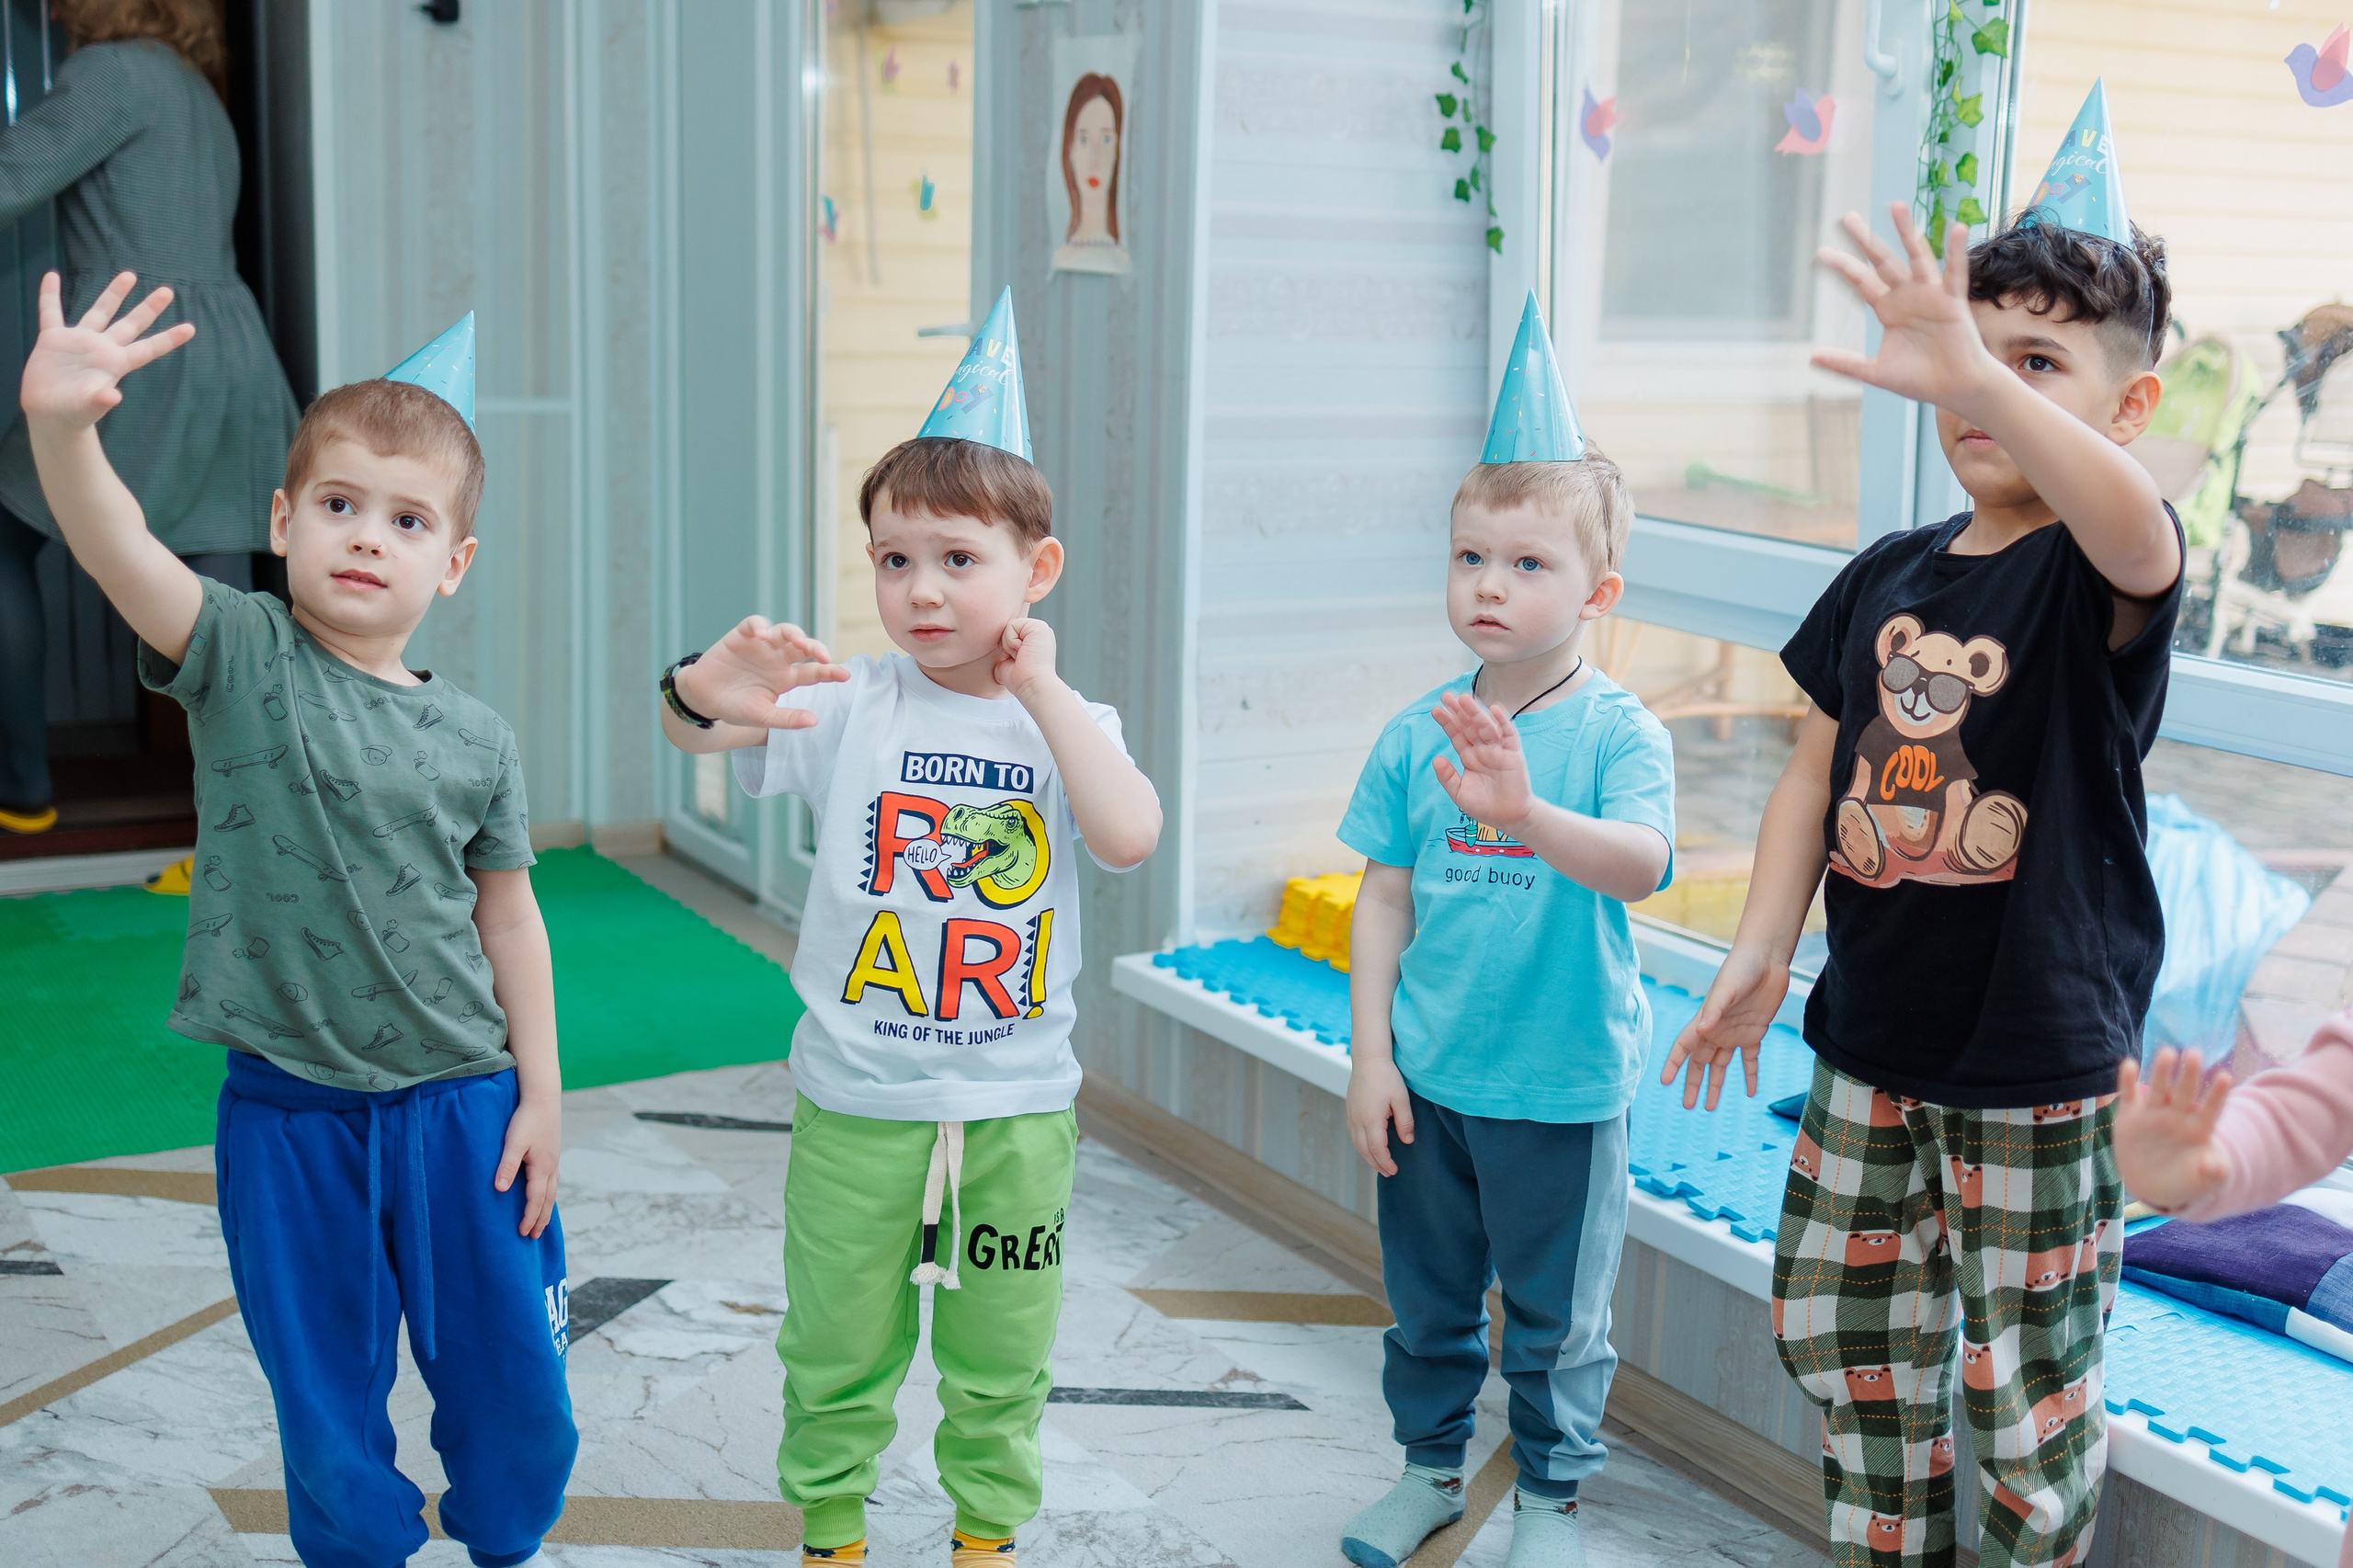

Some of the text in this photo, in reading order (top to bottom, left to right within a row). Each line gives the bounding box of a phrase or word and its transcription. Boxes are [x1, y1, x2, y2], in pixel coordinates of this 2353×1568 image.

[2059, 130, 2111, 157] AVE
[967, 337, 1014, 368] AVE
[226, 654, 235, 693] COOL
[905, 755, 1029, 790] BORN TO
[1880, 744, 1946, 801] COOL
[907, 845, 938, 863] HELLO
[1445, 865, 1536, 891] good buoy
[267, 892, 300, 903] COOL
[874, 1019, 1016, 1046] KING OF THE JUNGLE
[967, 1221, 1065, 1271] GREAT
